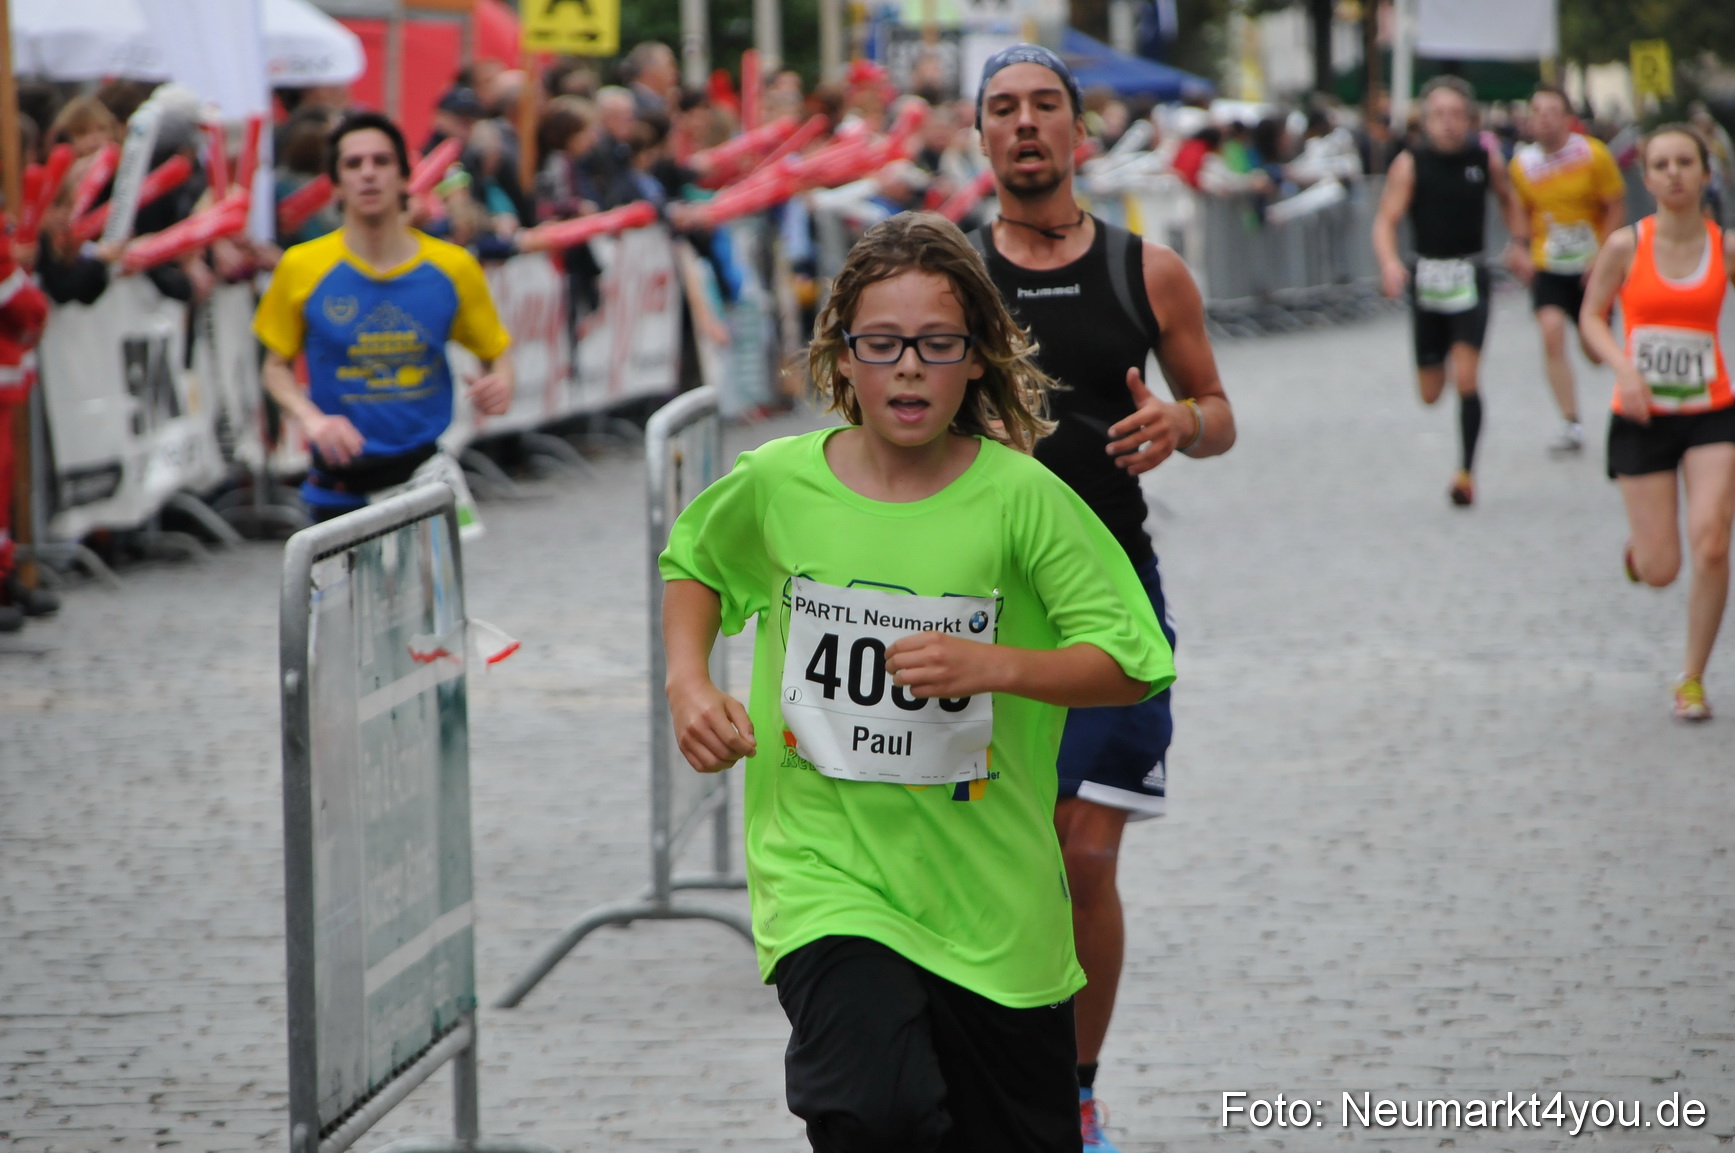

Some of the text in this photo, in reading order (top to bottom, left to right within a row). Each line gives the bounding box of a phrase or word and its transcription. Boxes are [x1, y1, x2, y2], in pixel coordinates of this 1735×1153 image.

[1017, 283, 1080, 298] hummel
[1637, 343, 1705, 377] 5001
[795, 596, 858, 624] PARTL
[863, 608, 962, 634] Neumarkt
[804, 632, 971, 712] 40
[852, 725, 912, 757] Paul
